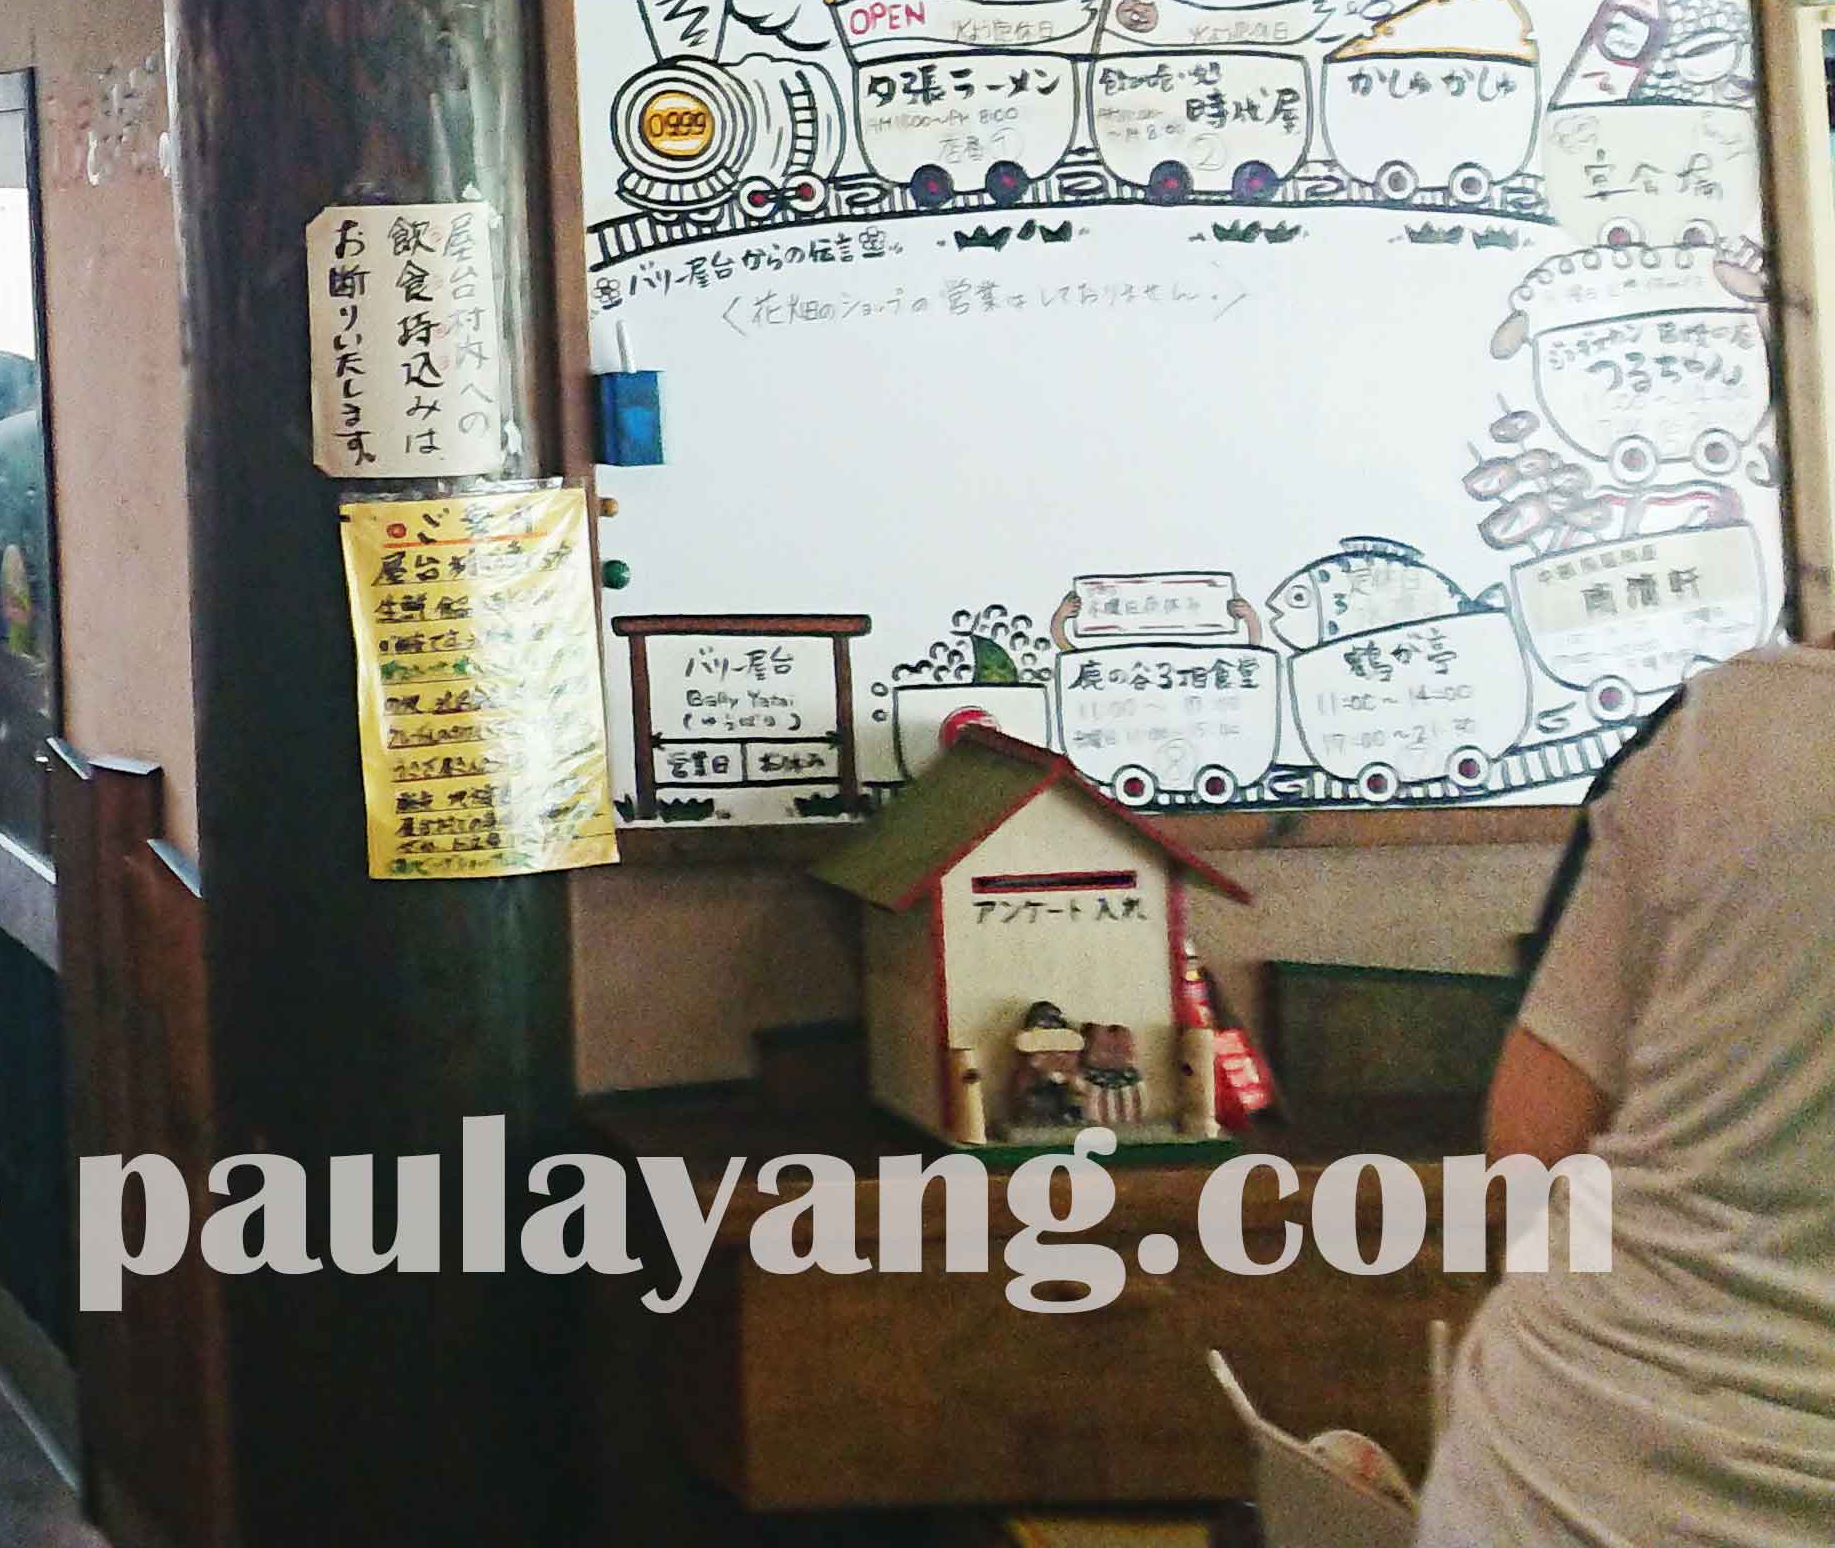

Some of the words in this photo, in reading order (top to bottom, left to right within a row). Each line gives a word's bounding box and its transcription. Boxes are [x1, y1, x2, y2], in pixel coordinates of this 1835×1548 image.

[849, 1, 926, 36] OPEN
[866, 63, 1061, 109] 夕張ラーメン
[387, 215, 444, 454] 飲食持込みは
[441, 210, 495, 436] 屋台村内への
[1585, 350, 1744, 395] つるちゃん
[666, 749, 731, 780] 営業日
